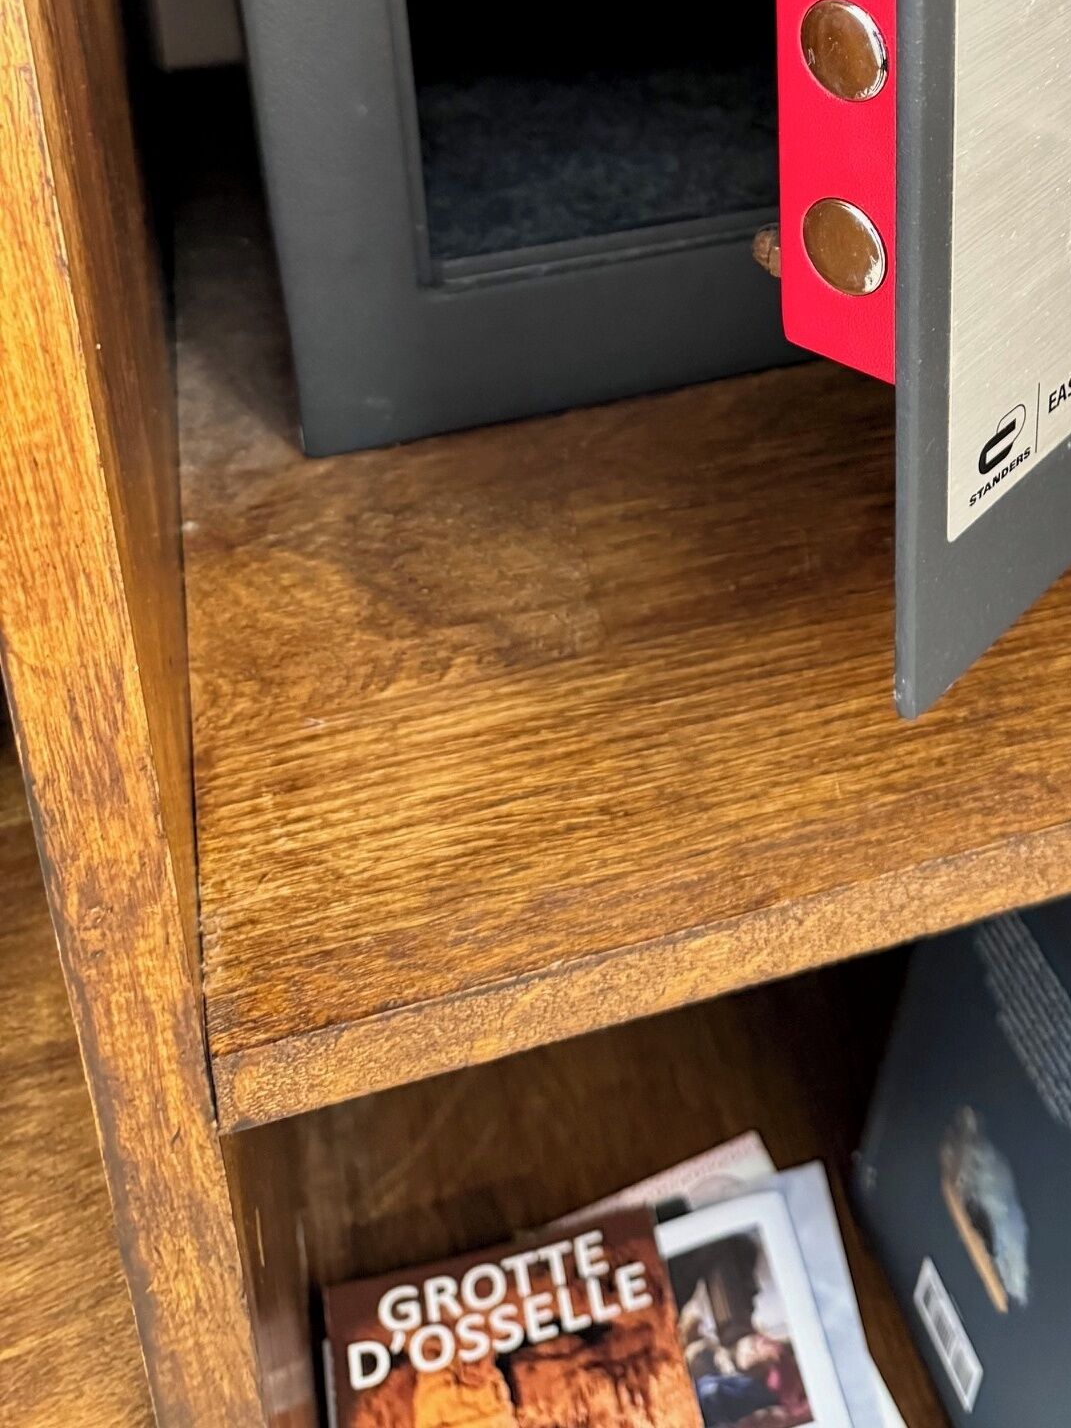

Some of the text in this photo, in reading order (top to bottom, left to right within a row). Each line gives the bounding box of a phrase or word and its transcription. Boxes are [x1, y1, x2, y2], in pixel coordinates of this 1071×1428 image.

[968, 446, 1031, 507] STANDERS
[346, 1260, 654, 1392] D'OSSELLE
[377, 1228, 610, 1333] GROTTE
